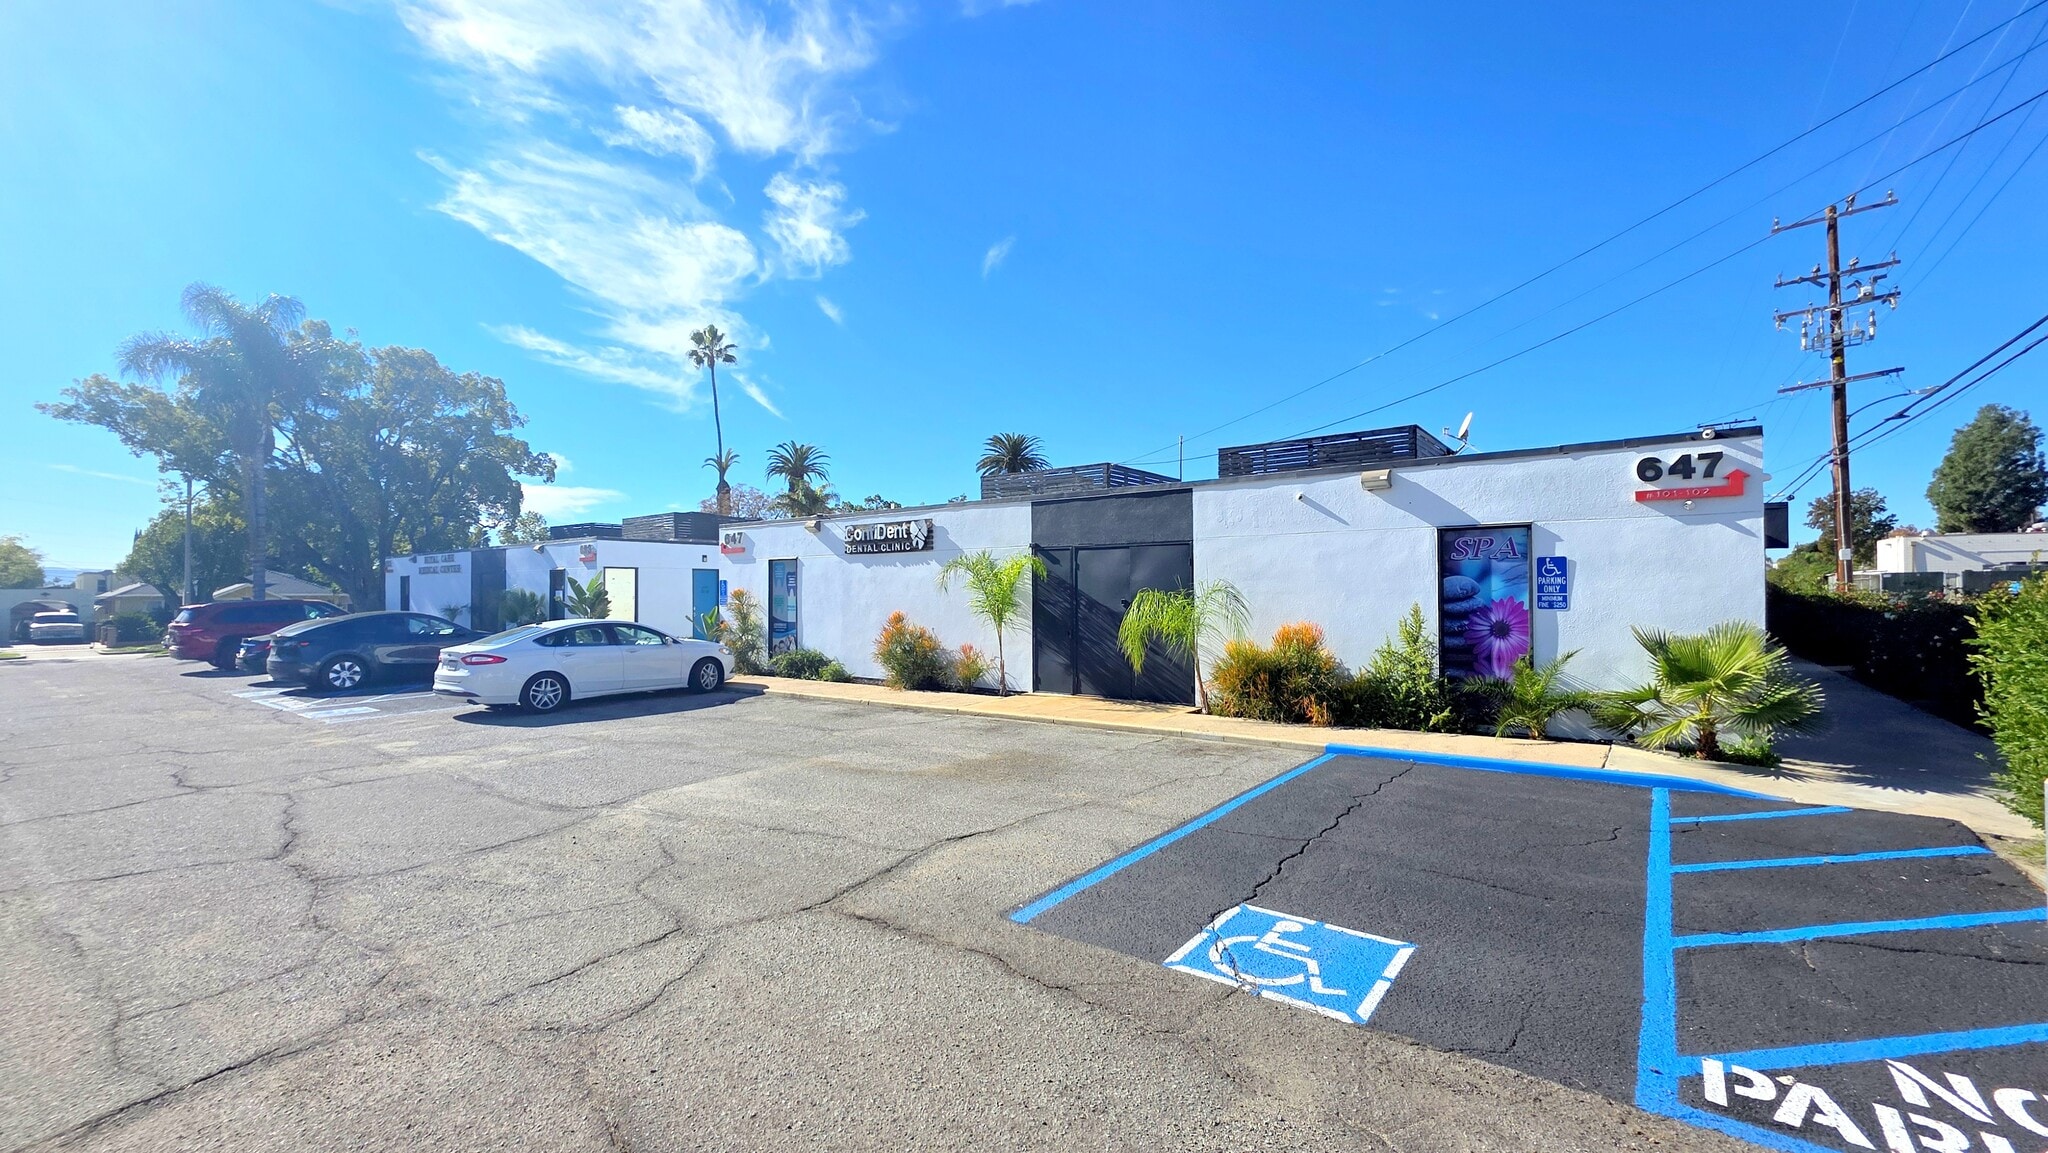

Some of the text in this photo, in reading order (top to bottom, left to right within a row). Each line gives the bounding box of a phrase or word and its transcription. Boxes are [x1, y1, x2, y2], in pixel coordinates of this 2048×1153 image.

[1636, 451, 1724, 482] 647
[724, 532, 743, 545] 647
[845, 542, 911, 554] DENTAL CLINIC
[1450, 536, 1522, 561] SPA
[1538, 576, 1567, 585] PARKING
[1543, 585, 1561, 593] ONLY
